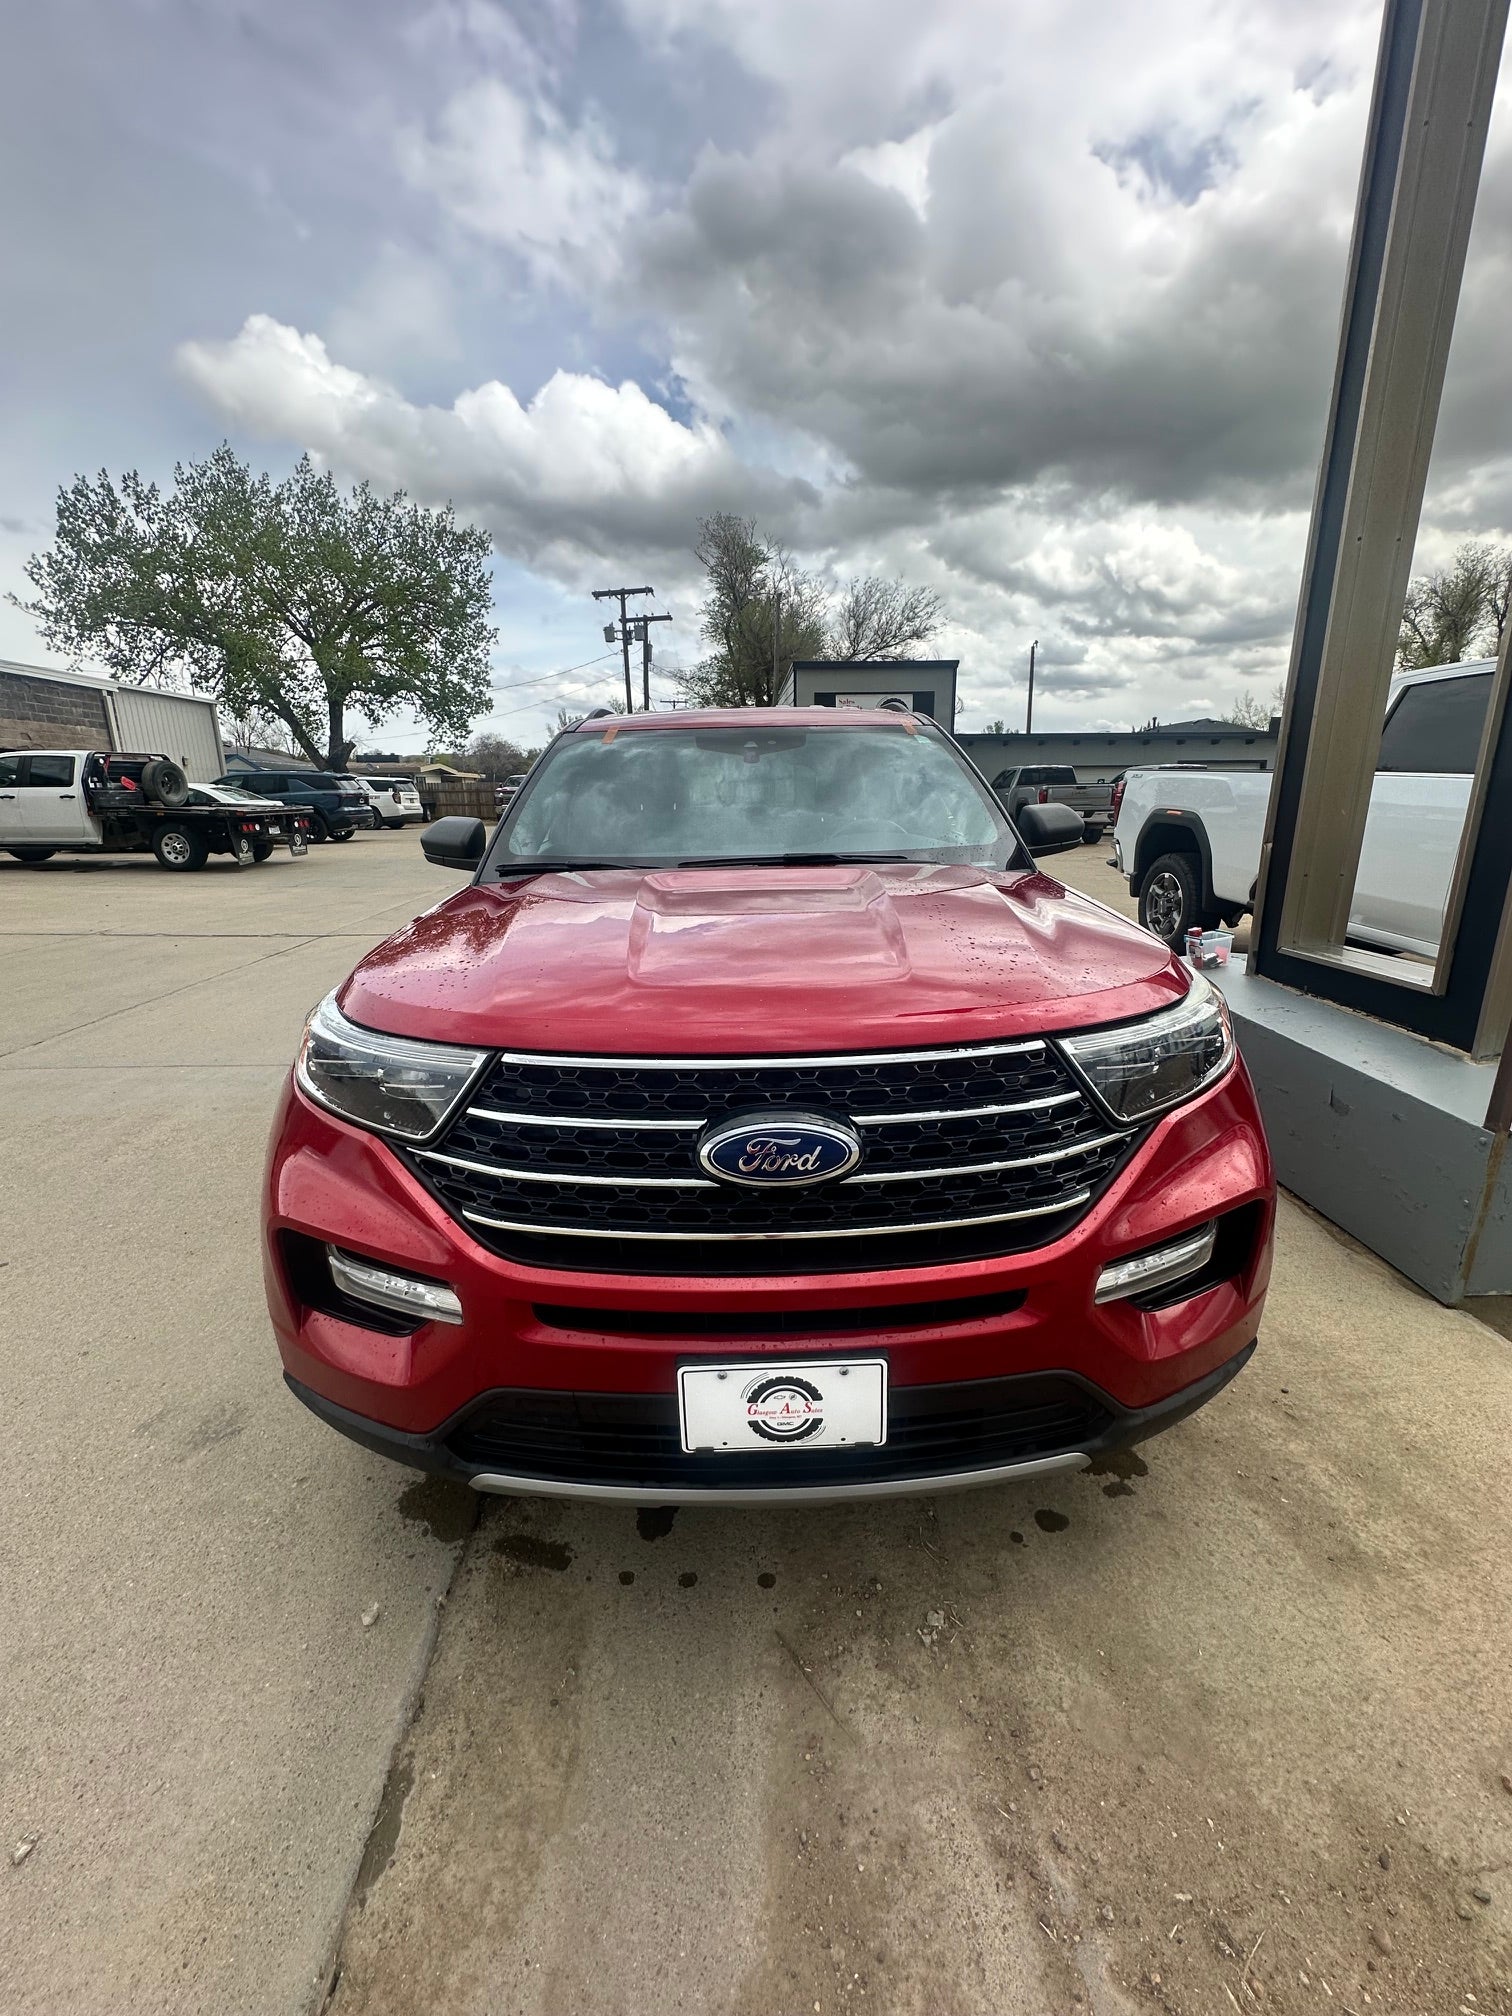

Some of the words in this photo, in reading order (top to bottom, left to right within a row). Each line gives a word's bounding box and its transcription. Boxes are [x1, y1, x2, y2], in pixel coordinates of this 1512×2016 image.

[738, 1137, 822, 1172] Ford
[747, 1403, 777, 1416] Glasgow
[780, 1402, 800, 1414] Auto
[802, 1401, 823, 1414] Sales
